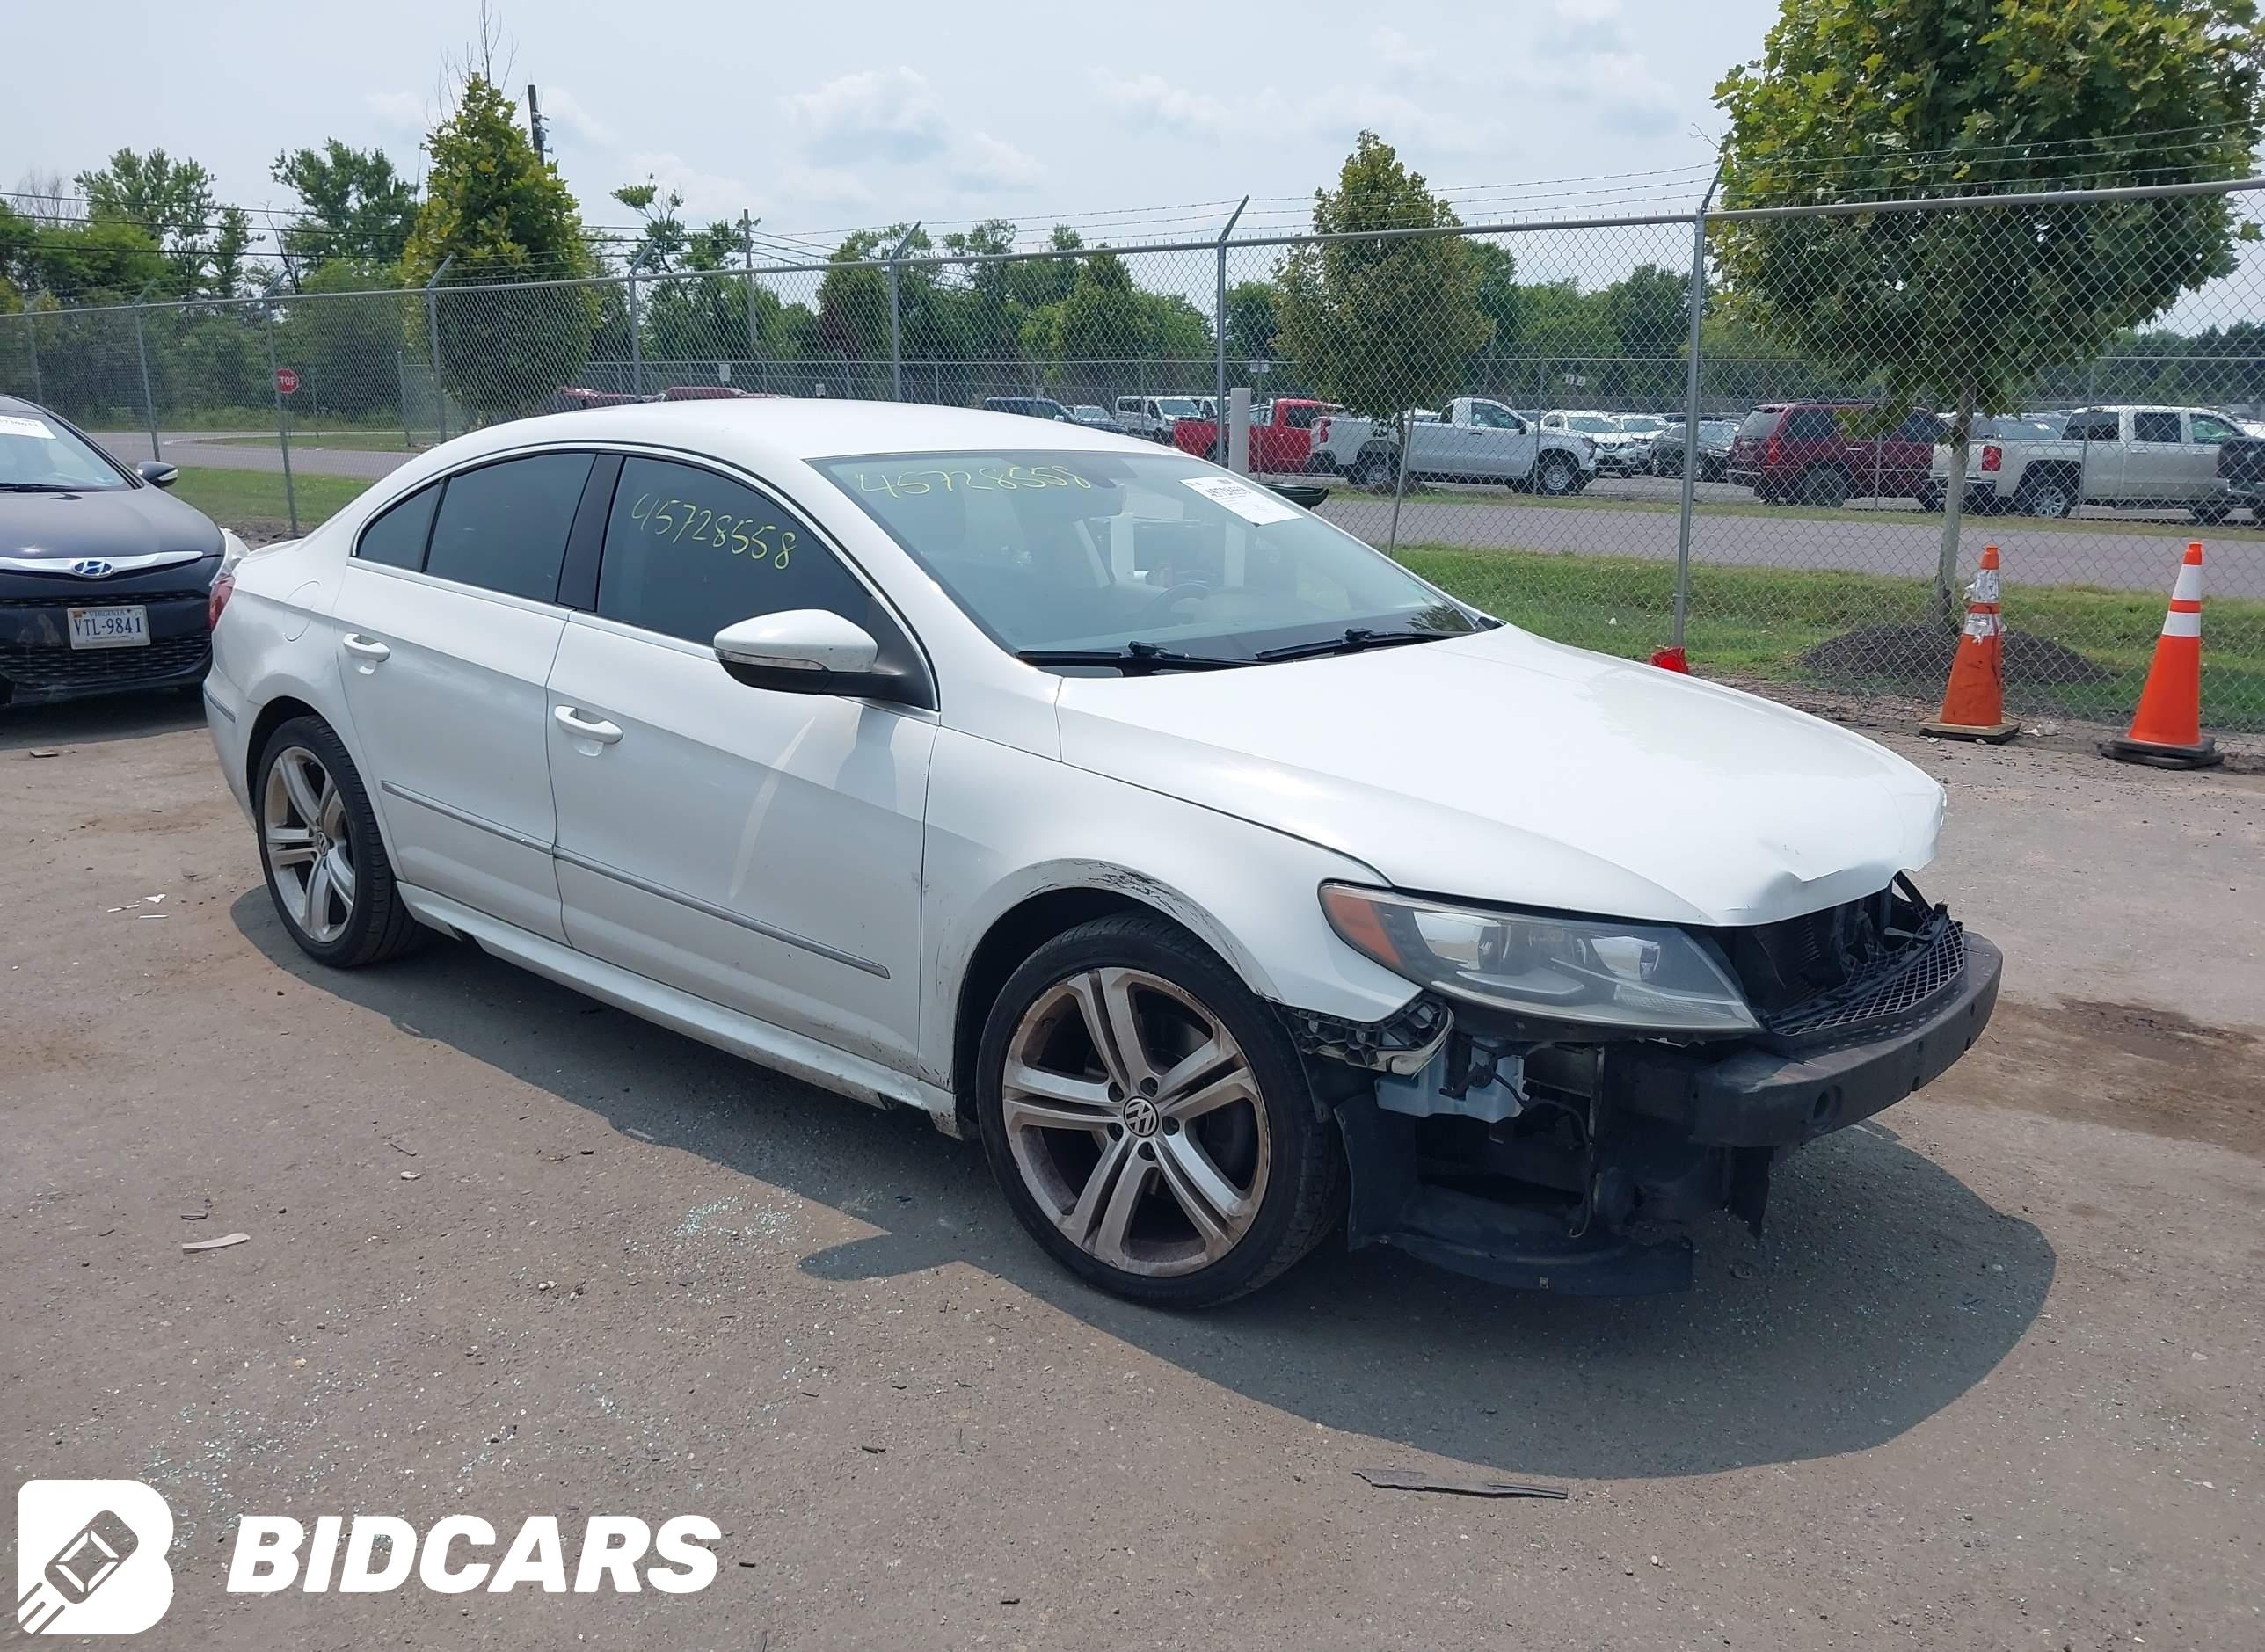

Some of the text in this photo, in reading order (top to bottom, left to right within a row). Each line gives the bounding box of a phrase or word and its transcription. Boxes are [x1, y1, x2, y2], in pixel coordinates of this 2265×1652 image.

[856, 465, 1091, 499] 45728558
[631, 492, 797, 570] 45728558
[73, 617, 142, 637] VTL-9841
